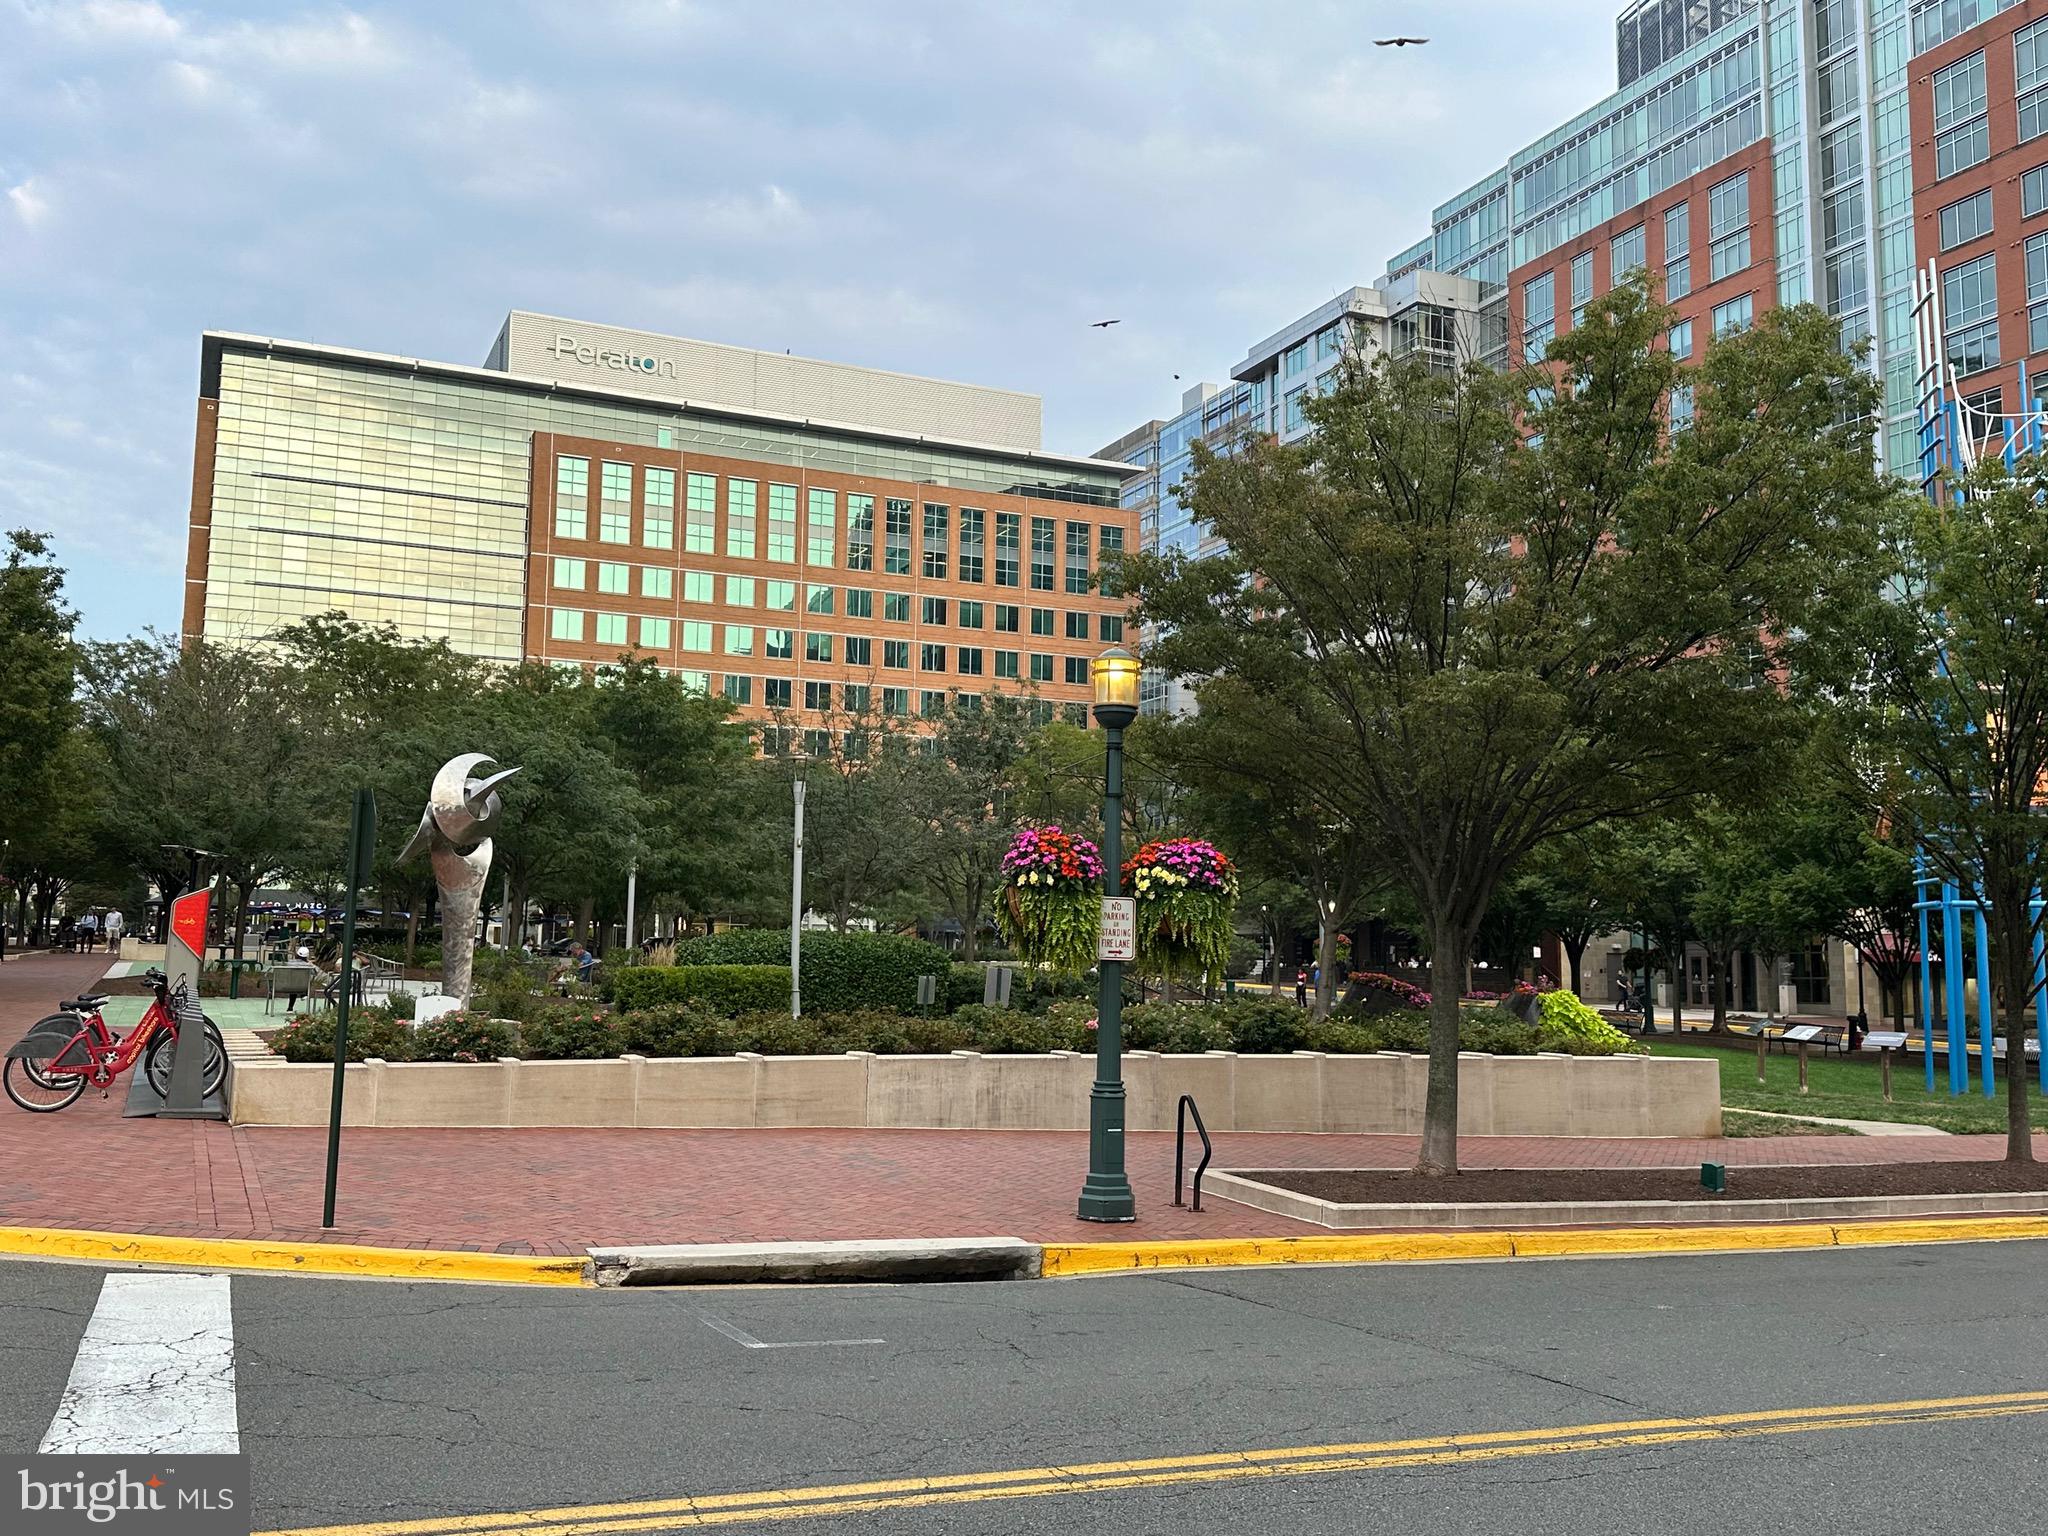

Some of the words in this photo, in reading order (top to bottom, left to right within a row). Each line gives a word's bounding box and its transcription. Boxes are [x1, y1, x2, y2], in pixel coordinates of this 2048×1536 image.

[554, 333, 677, 379] Peraton
[1111, 902, 1122, 911] NO
[1103, 912, 1130, 921] PARKING
[1102, 928, 1131, 938] STANDING
[1102, 939, 1113, 948] FIRE
[1115, 939, 1130, 949] LANE
